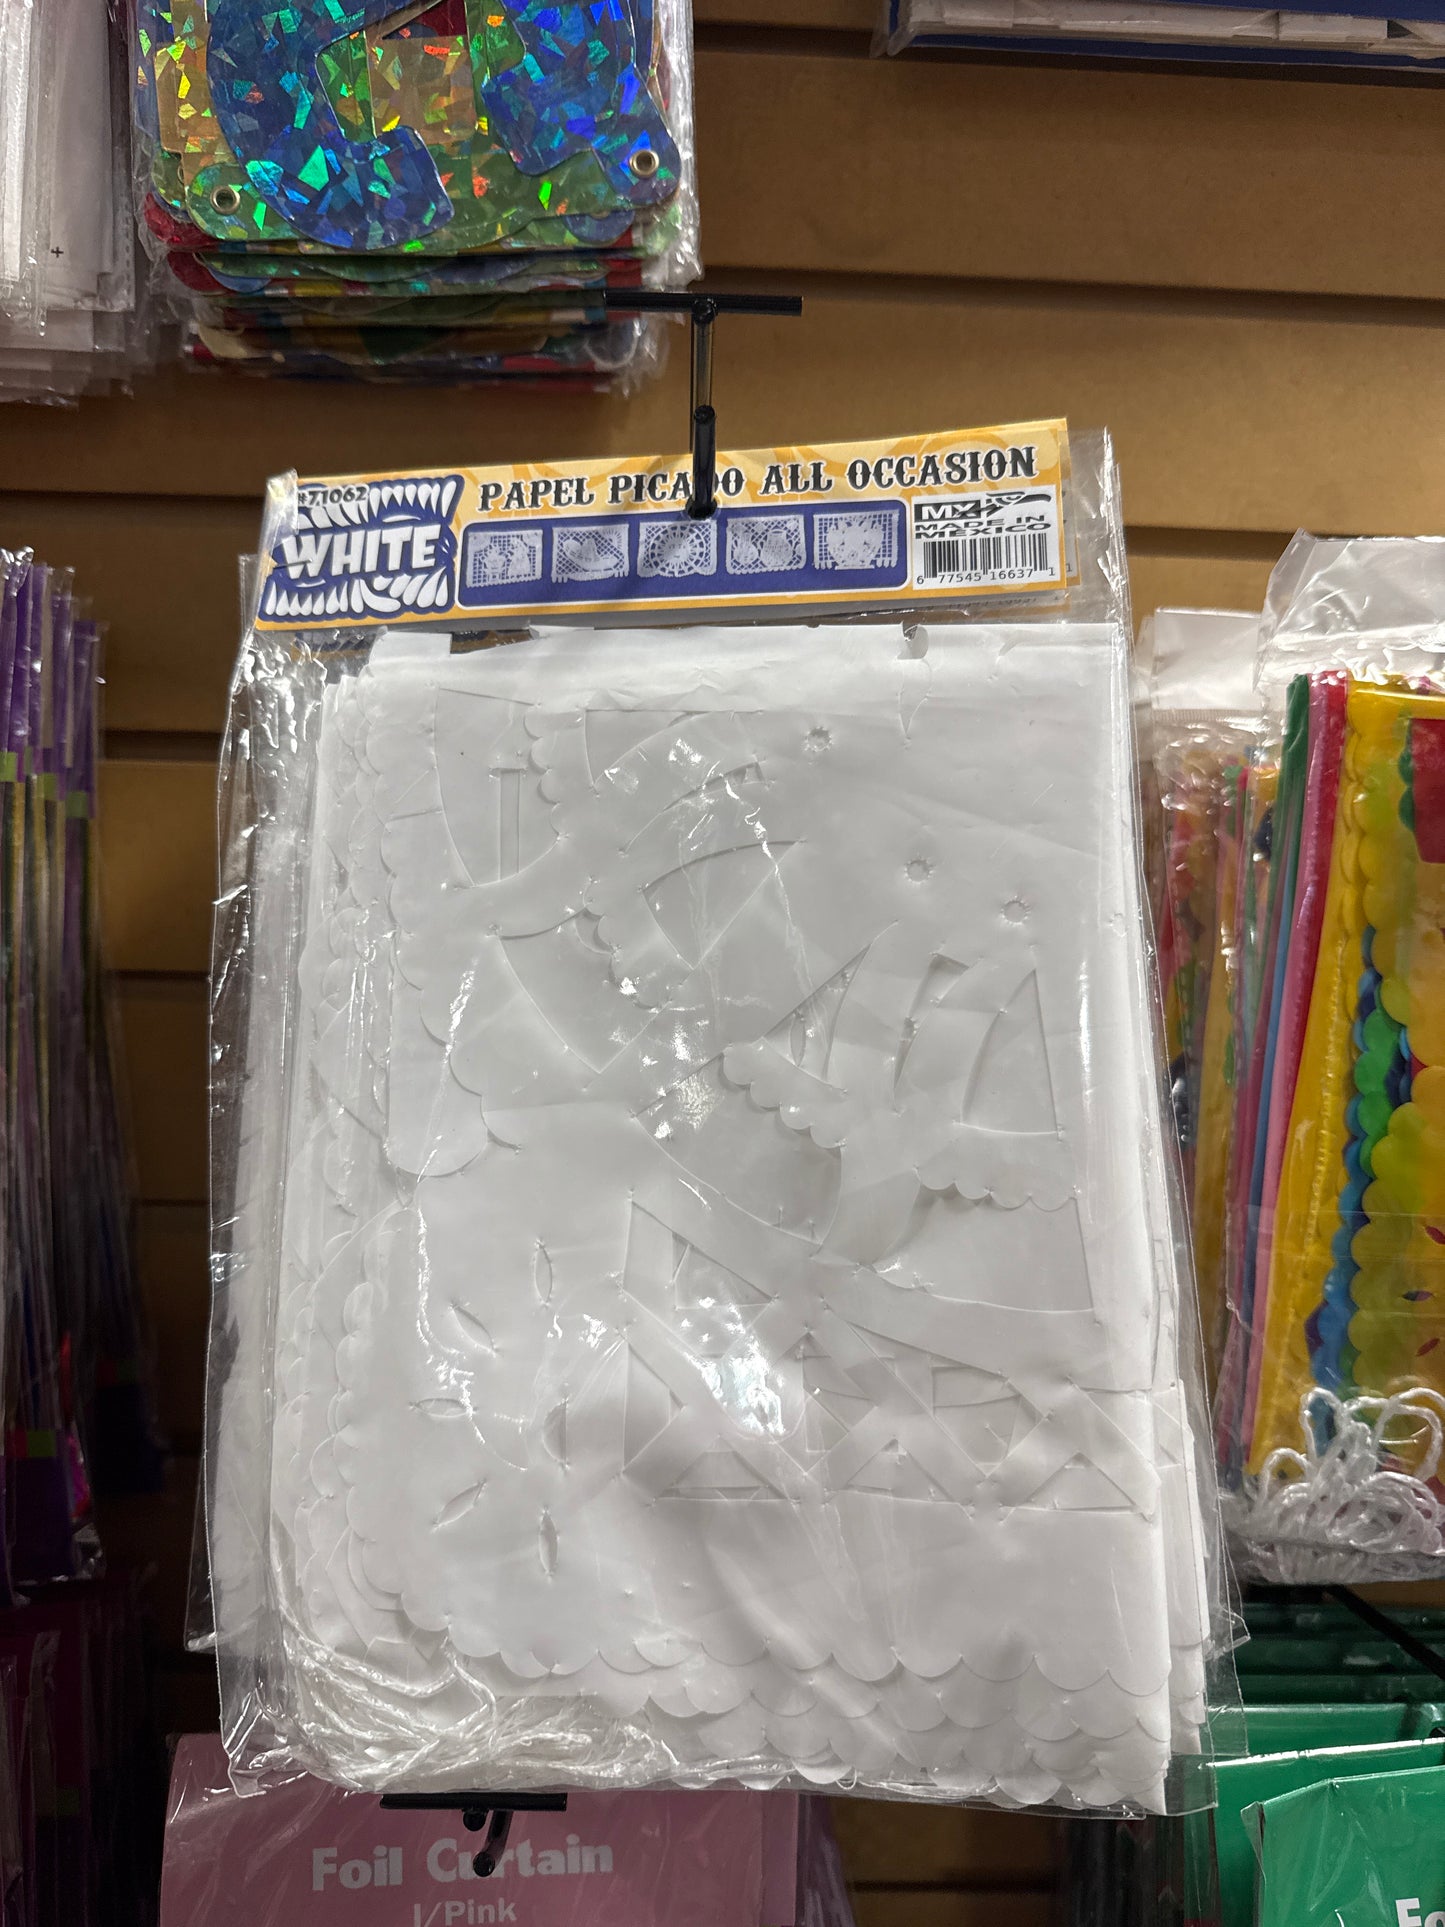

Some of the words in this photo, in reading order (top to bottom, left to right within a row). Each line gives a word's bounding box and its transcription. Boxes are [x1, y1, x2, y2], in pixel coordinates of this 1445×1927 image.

[478, 477, 595, 511] PAPEL
[608, 467, 745, 504] PICAO
[760, 461, 833, 495] ALL
[846, 446, 1038, 490] OCCASION
[915, 519, 1005, 531] MADE
[1016, 515, 1045, 524] IN
[915, 523, 1052, 540] MEXICO
[281, 524, 442, 579] WHITE
[916, 575, 925, 585] 6
[938, 571, 982, 584] 77545
[990, 568, 1034, 581] 16637
[1049, 566, 1056, 577] 1
[312, 1845, 403, 1891] Foil
[427, 1833, 614, 1882] Curtain
